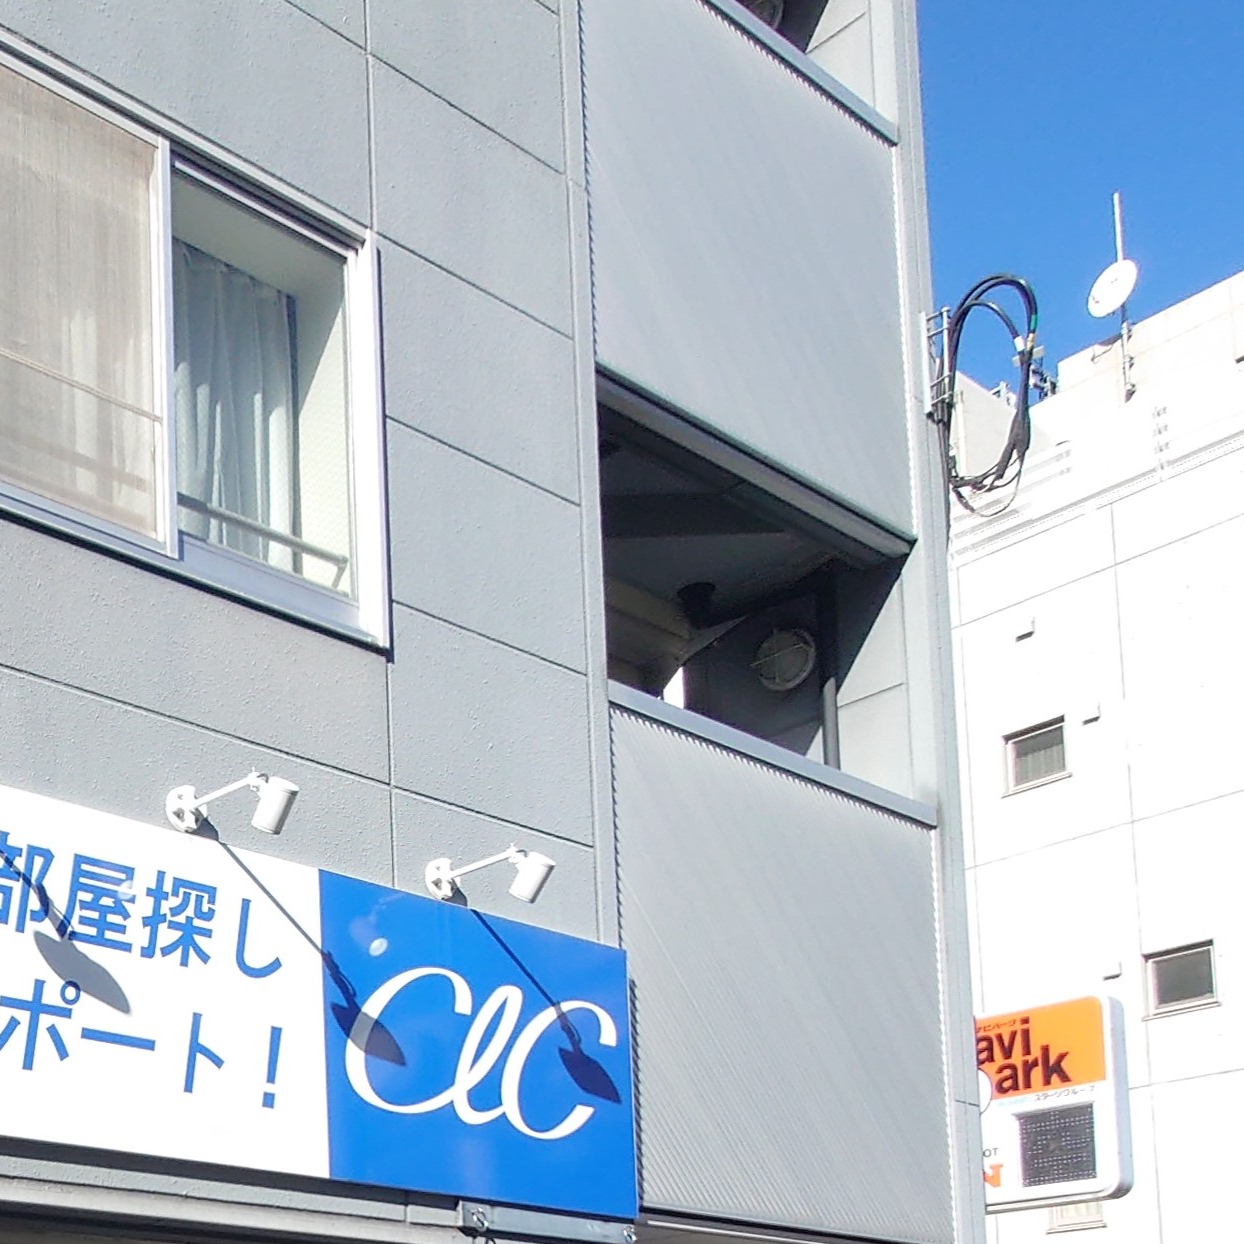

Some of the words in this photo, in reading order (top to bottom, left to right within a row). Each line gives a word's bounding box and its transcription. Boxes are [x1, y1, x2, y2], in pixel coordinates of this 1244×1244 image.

[976, 1016, 1032, 1066] avi
[995, 1044, 1072, 1094] ark
[983, 1147, 999, 1158] OT
